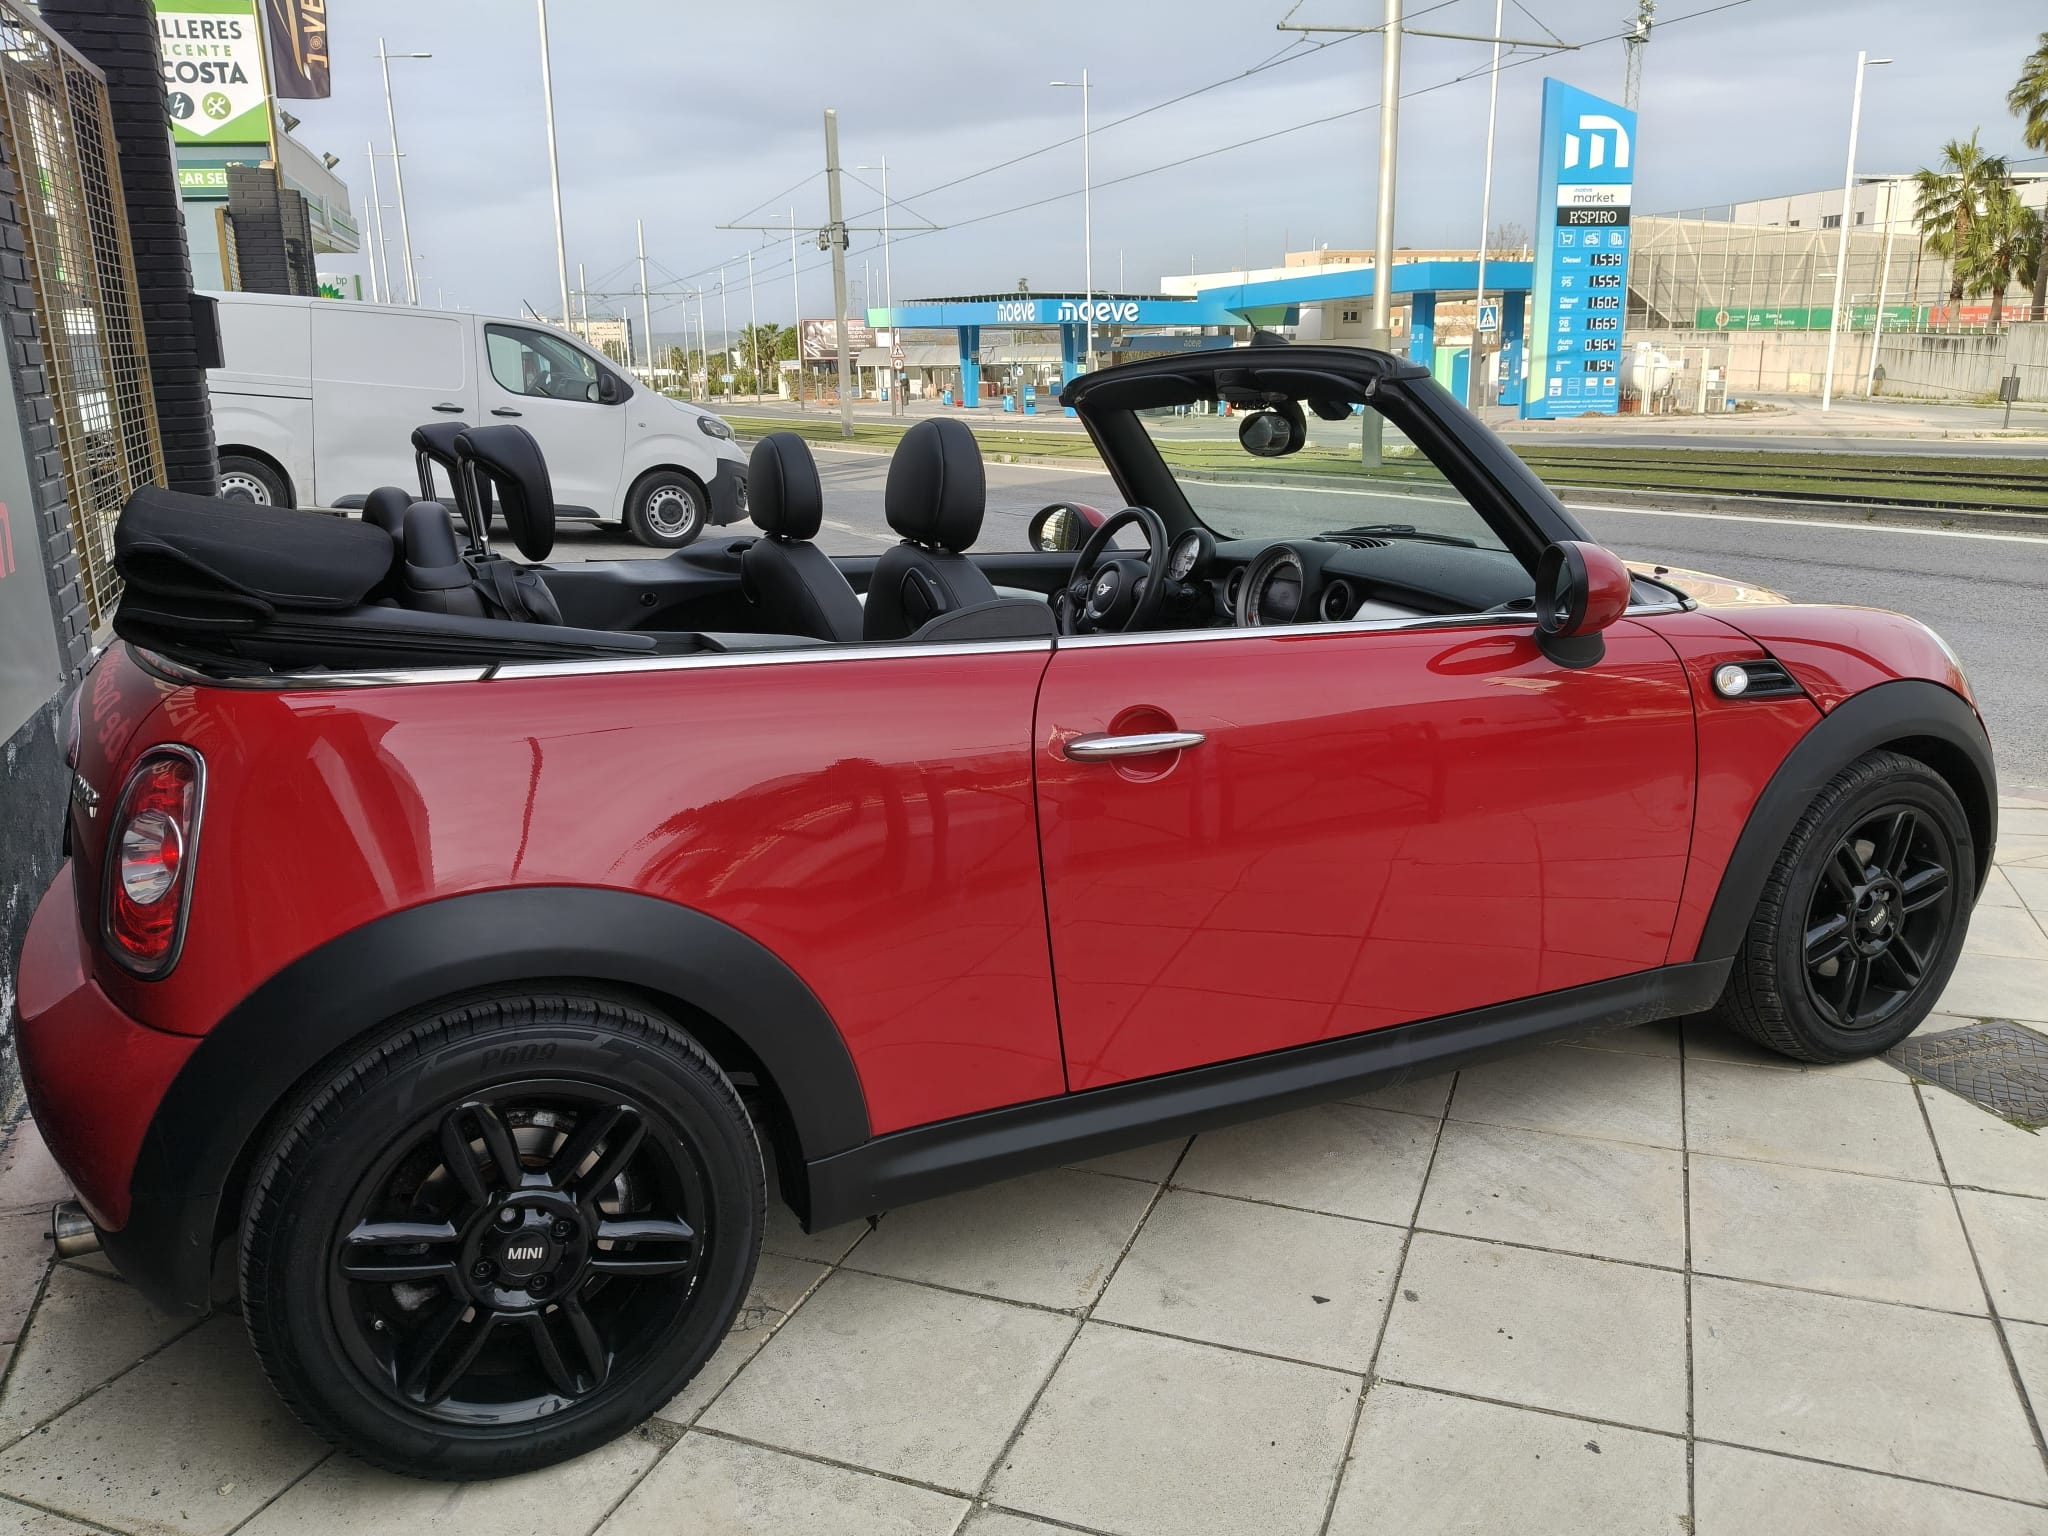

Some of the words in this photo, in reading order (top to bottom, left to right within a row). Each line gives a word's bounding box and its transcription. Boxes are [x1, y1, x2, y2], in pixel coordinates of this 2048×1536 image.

[1573, 193, 1615, 203] market
[1569, 211, 1618, 224] R'SPIRO
[1562, 256, 1582, 264] Diesel
[1594, 254, 1622, 266] 1.539
[335, 275, 348, 286] bp
[1561, 279, 1572, 287] 95
[1592, 275, 1620, 287] 1.552
[1559, 296, 1579, 305] Diesel
[1591, 296, 1619, 309] 1.602
[997, 302, 1036, 322] moeve
[1057, 301, 1139, 322] moeve
[1559, 319, 1569, 327] 98
[1590, 317, 1617, 330] 1.669
[1584, 338, 1616, 351] 0.964
[1586, 359, 1614, 372] 1.194
[1870, 908, 1886, 927] MINI
[507, 1247, 543, 1260] MINI
